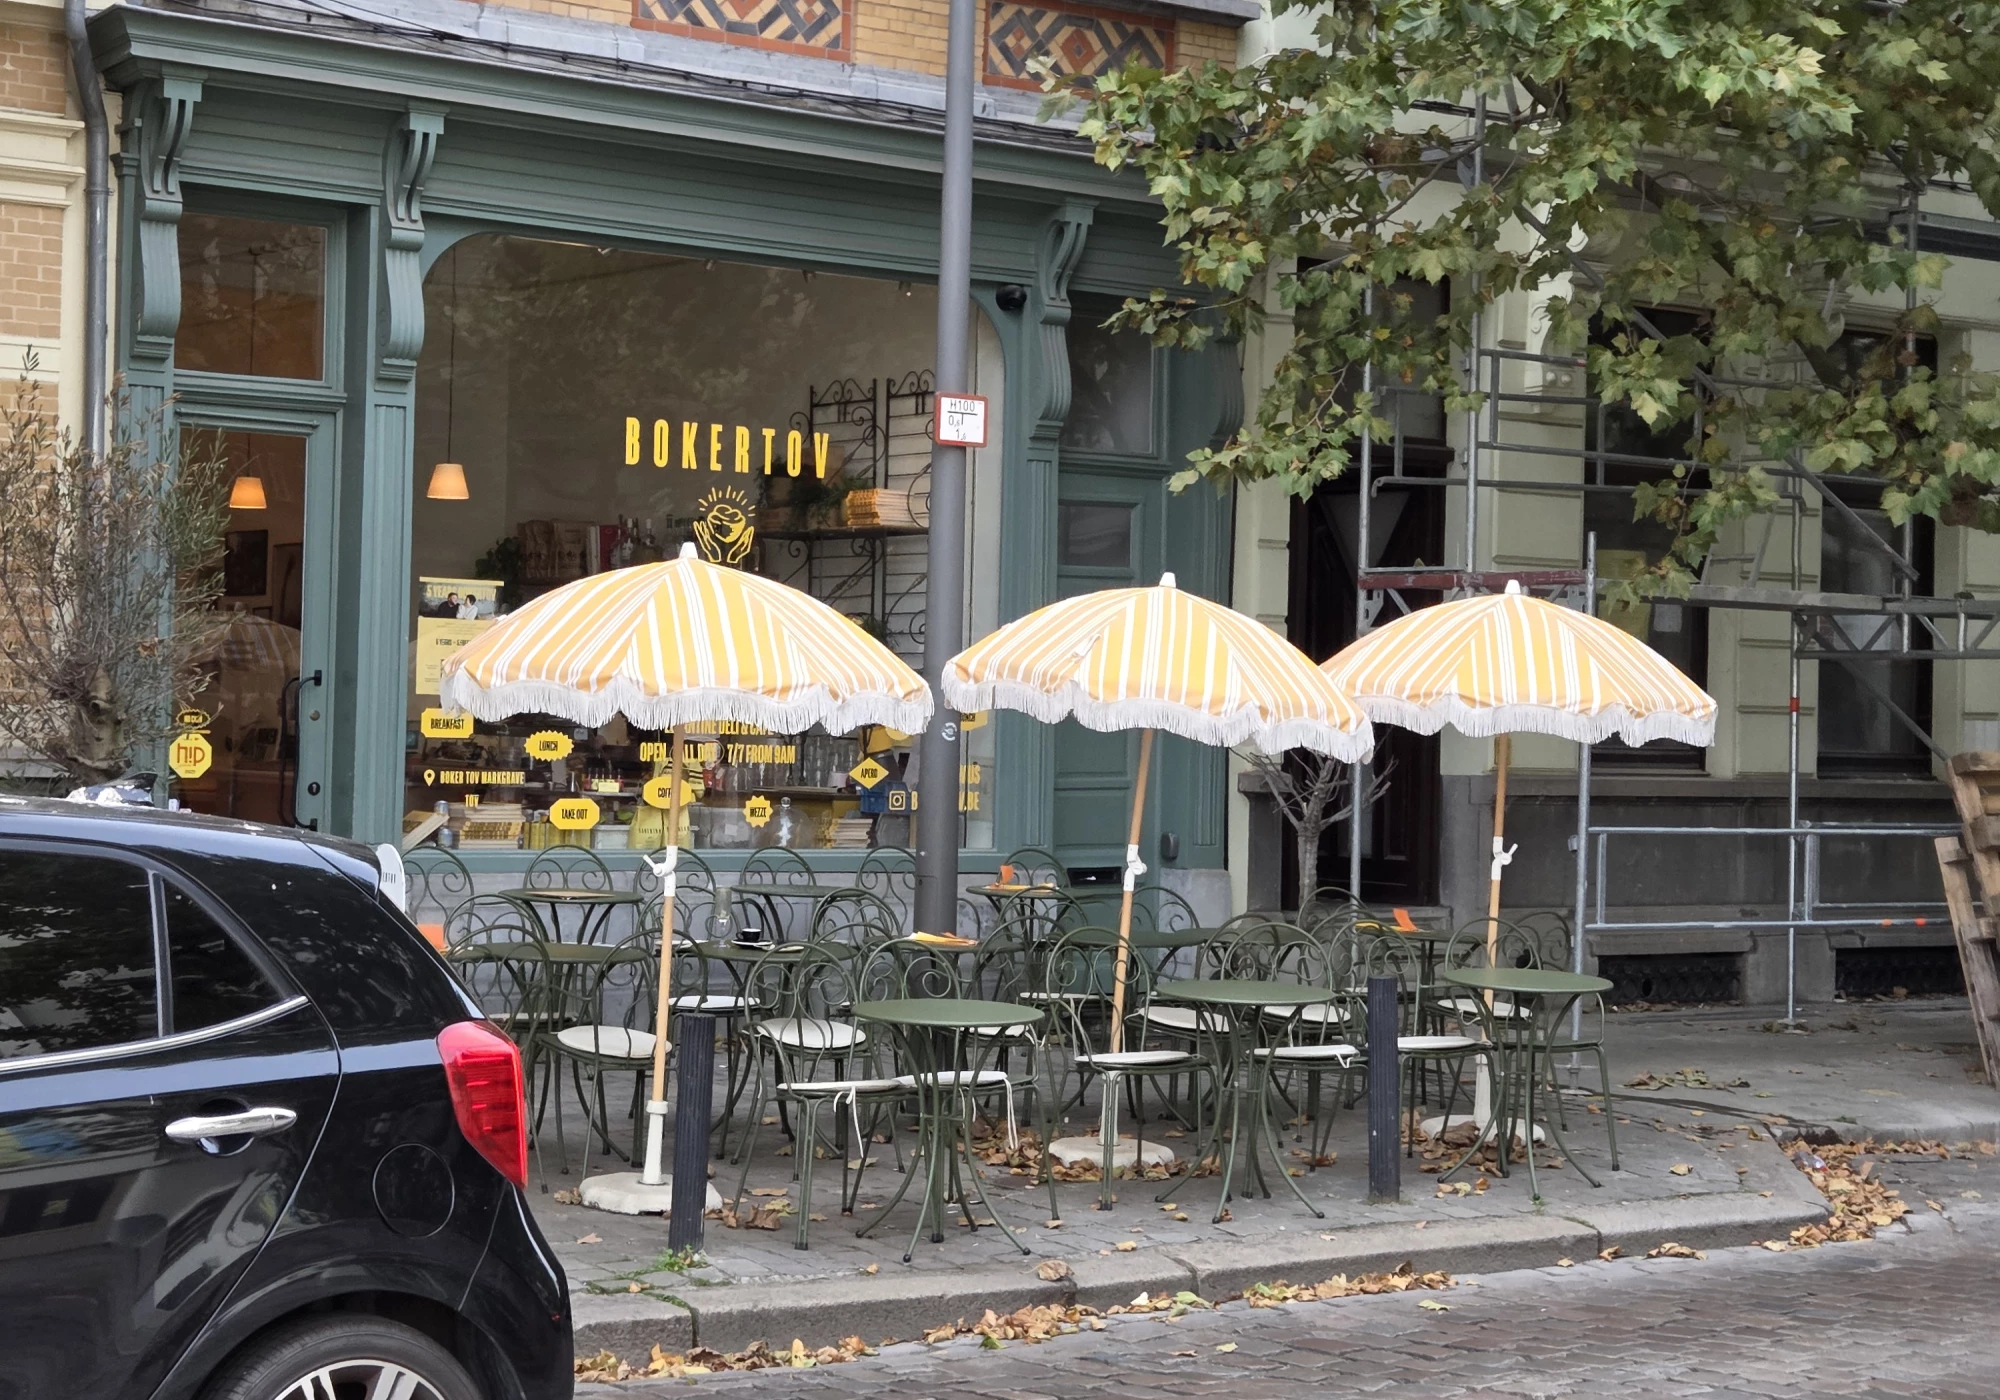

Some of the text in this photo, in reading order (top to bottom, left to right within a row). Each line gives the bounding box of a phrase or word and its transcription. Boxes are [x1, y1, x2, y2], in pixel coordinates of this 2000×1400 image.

[950, 400, 975, 412] H100
[430, 718, 465, 730] BREAKFAST
[539, 740, 558, 751] LUNCH
[639, 742, 667, 762] OPEN
[727, 743, 745, 766] 7/7
[746, 744, 773, 763] FROM
[774, 745, 796, 764] 9AM
[440, 771, 525, 785] BOKER TOV MARKGRAVE
[657, 787, 671, 798] COFF
[465, 794, 480, 807] TOV
[561, 808, 588, 820] TAKE OUT
